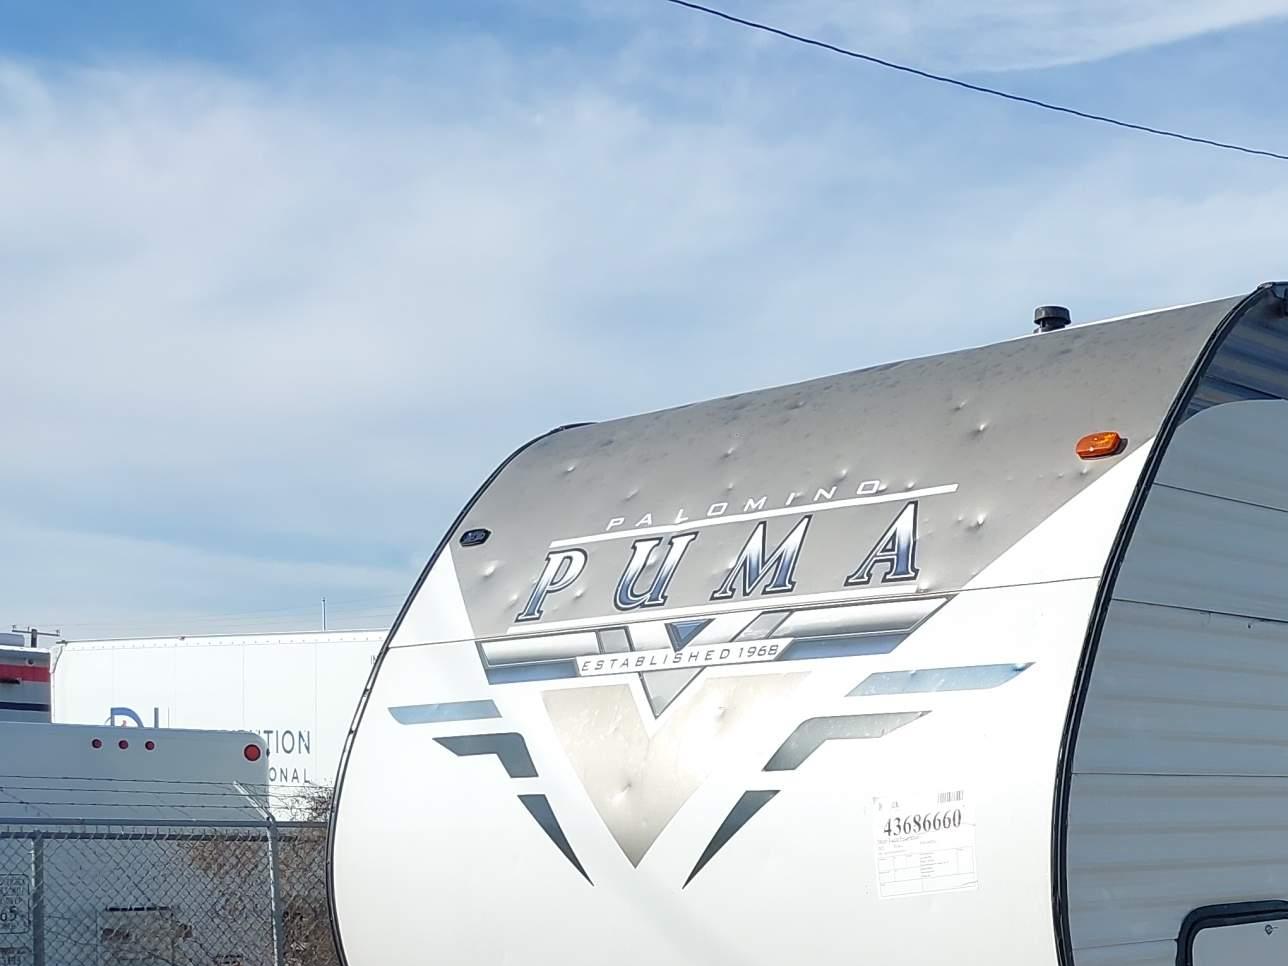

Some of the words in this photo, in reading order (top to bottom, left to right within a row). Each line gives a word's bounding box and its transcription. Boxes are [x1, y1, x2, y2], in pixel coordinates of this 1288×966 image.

[606, 480, 880, 531] PALOMINO
[515, 500, 919, 623] PUMA
[581, 648, 731, 672] ESTABLISHED
[738, 644, 779, 659] 1968
[883, 808, 962, 837] 43686660
